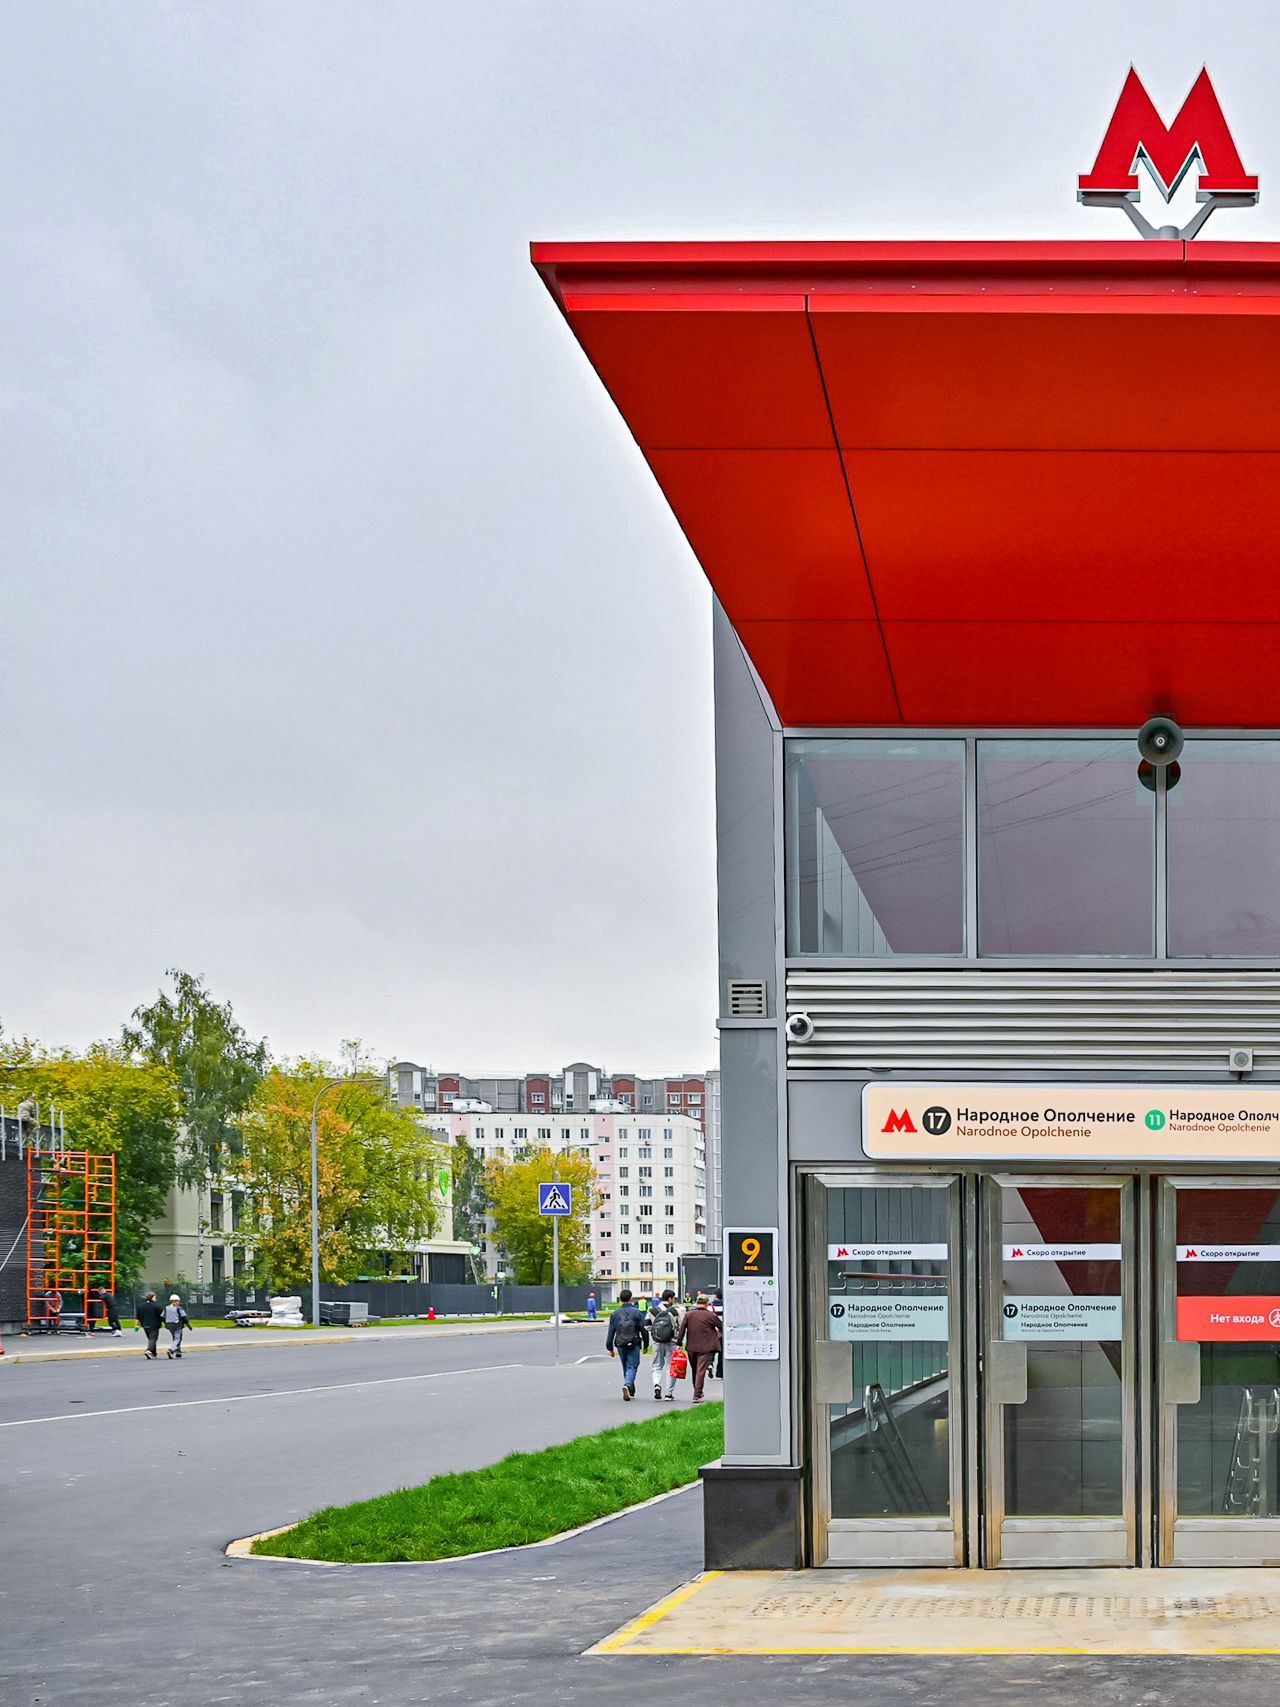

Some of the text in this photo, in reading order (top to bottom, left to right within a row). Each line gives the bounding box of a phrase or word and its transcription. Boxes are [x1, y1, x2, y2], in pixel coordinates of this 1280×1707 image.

[926, 1112, 948, 1130] 17
[956, 1107, 1136, 1125] Народное Ополчение
[1148, 1113, 1161, 1127] 11
[1168, 1109, 1235, 1124] Народное
[956, 1125, 1093, 1139] Narodnoe Opolchenie
[1168, 1123, 1271, 1133] Narodnoe Opolchenie
[741, 1238, 761, 1264] 9
[852, 1248, 875, 1256] Скоро
[1026, 1249, 1050, 1257] Скоро
[1200, 1250, 1224, 1258] Скоро
[832, 1306, 843, 1316] 17
[848, 1303, 945, 1313] Народное Ополчение
[1005, 1306, 1016, 1316] 17
[1020, 1303, 1117, 1313] Народное Ополчение
[1210, 1313, 1265, 1325] Нет входа
